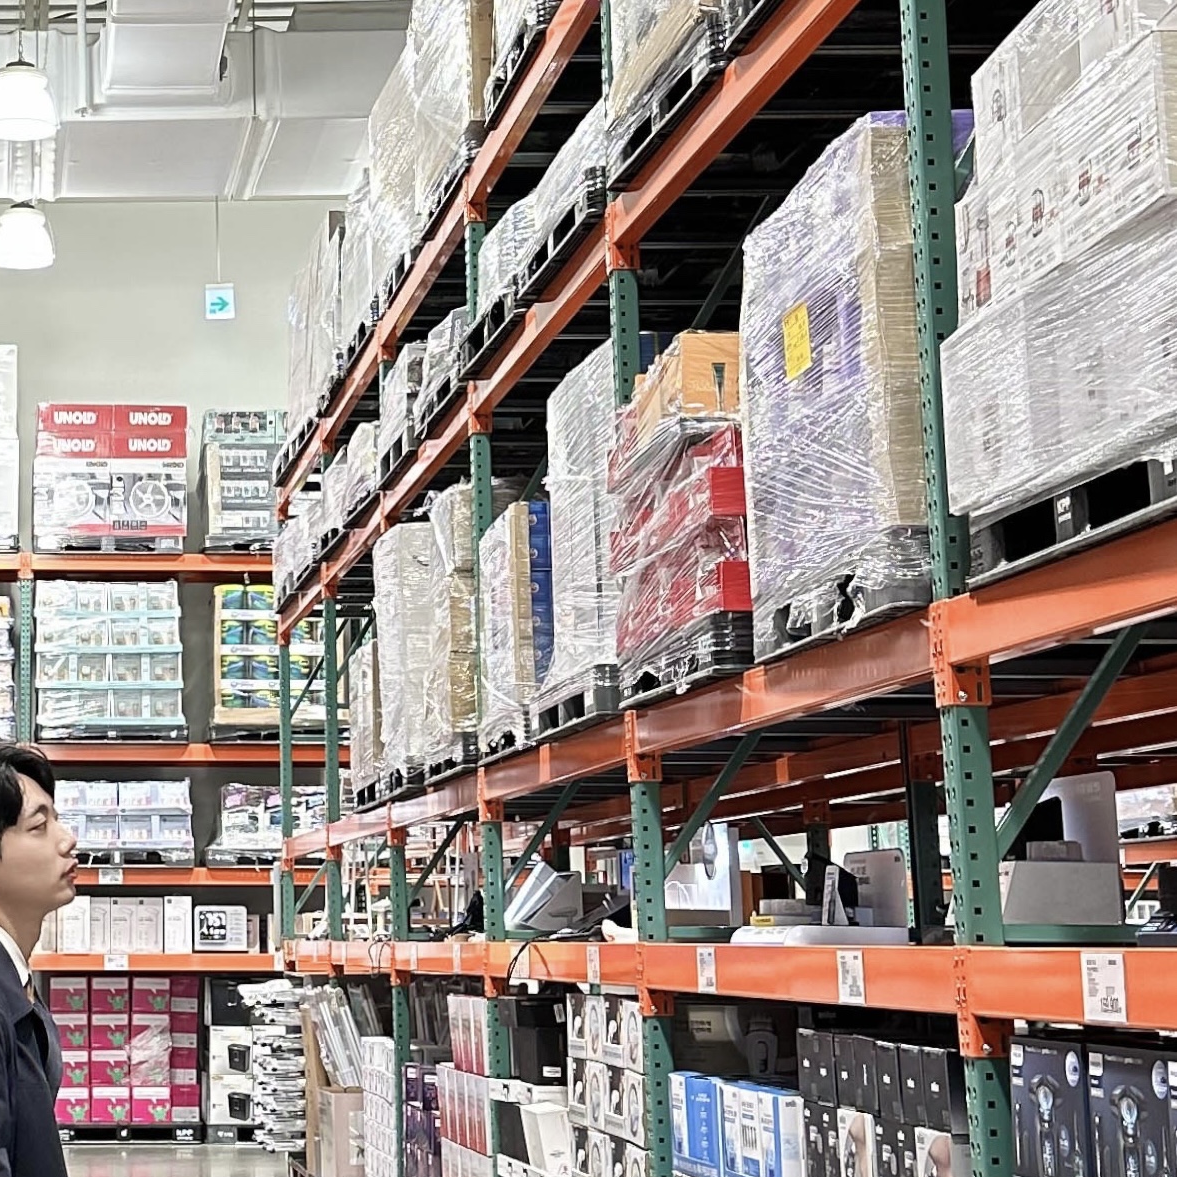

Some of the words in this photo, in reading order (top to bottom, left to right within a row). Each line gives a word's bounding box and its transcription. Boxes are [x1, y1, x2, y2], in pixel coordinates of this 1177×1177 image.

[53, 411, 97, 425] UNOLD
[129, 411, 173, 426] UNOLD
[128, 438, 172, 452] UNOLD
